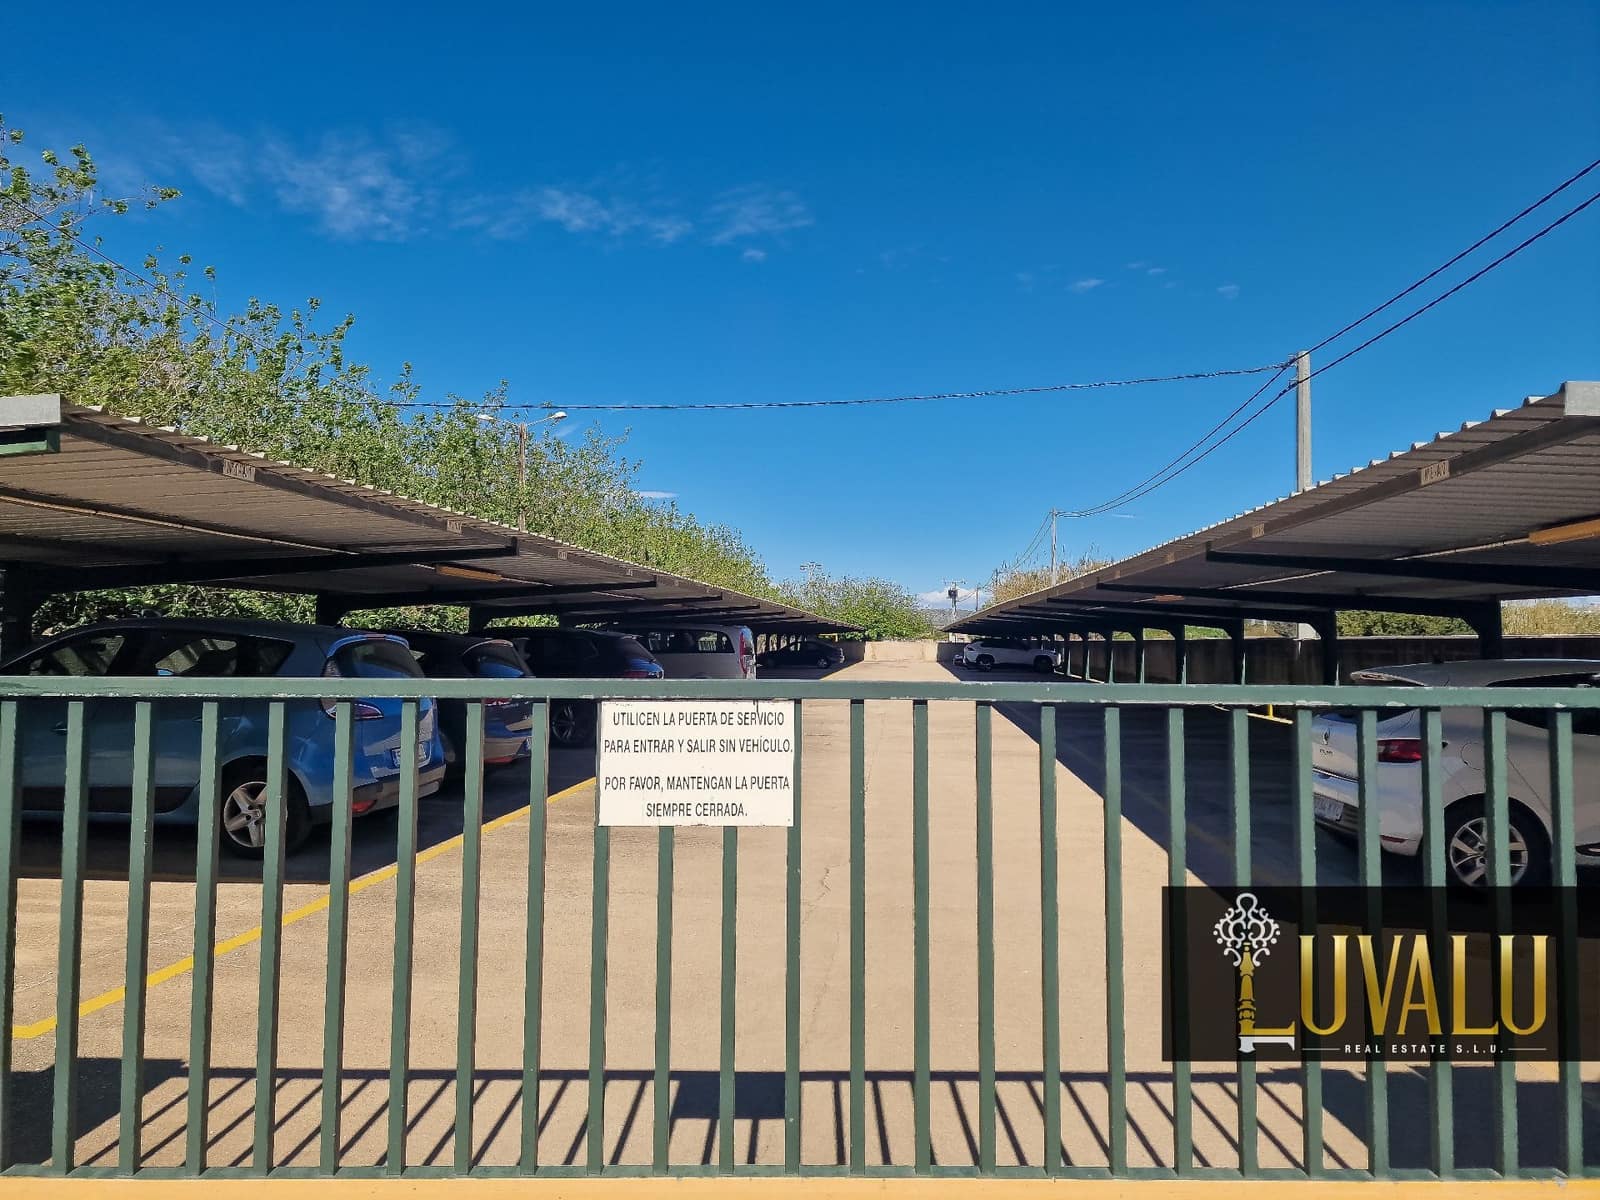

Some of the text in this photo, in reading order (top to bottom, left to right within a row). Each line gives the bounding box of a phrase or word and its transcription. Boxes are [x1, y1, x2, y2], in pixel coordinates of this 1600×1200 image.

[613, 711, 785, 726] UTILICEN LA PUERTA DE SERVICIO
[604, 735, 793, 753] PARA ENTRAR Y SALIR SIN VEHÍCULO.
[604, 776, 790, 792] POR FAVOR, MANTENGAN LA PUERTA
[646, 803, 748, 817] SIEMPRE CERRADA.
